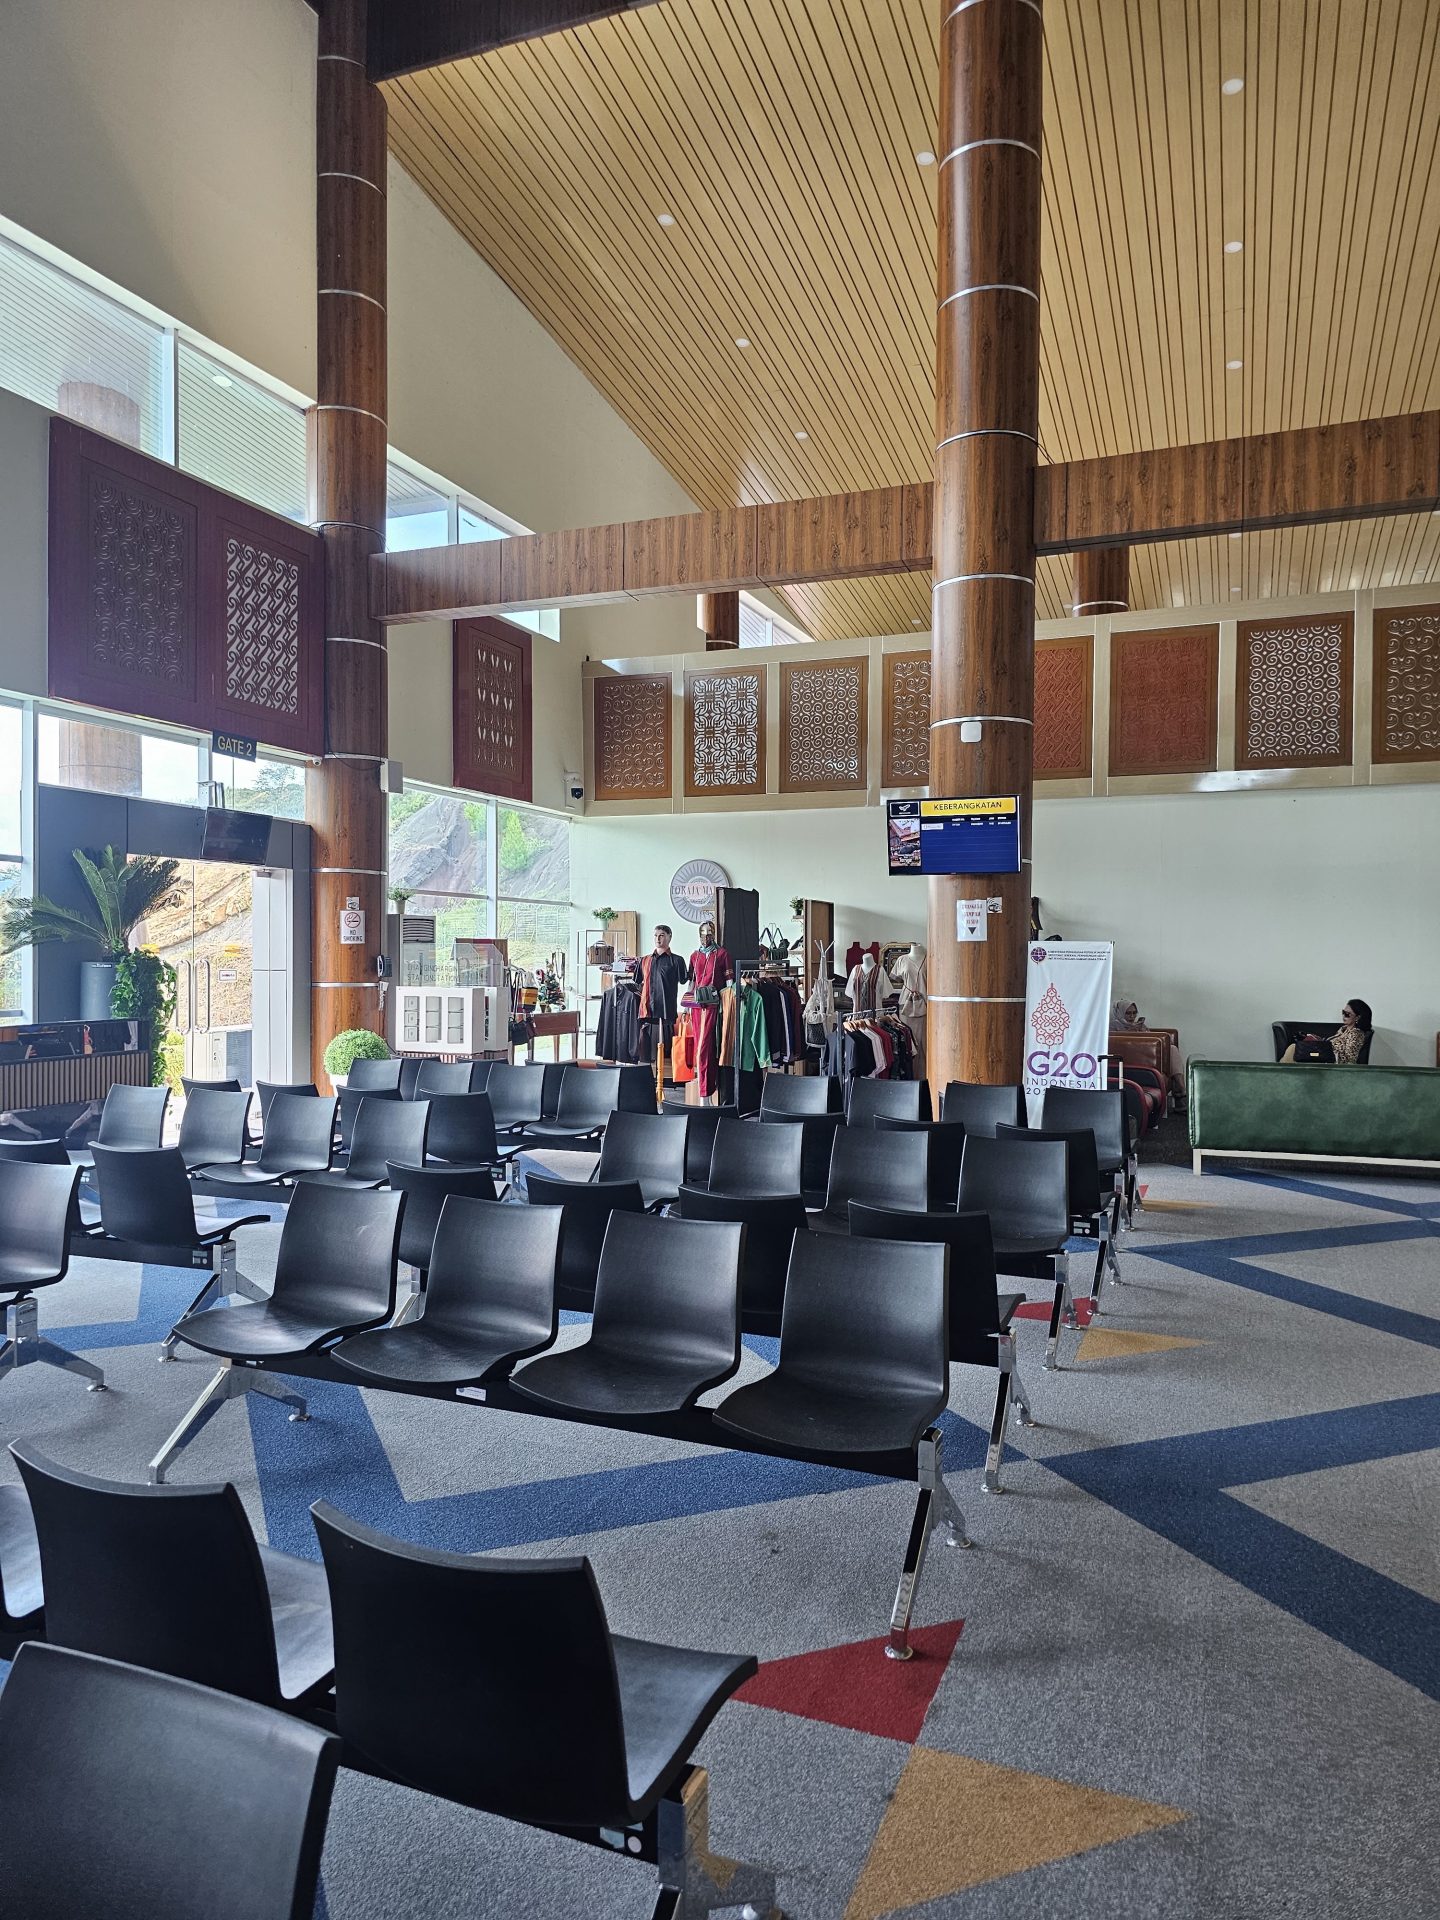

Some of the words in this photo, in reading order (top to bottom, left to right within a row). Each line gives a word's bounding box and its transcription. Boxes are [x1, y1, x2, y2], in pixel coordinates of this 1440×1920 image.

[217, 735, 244, 755] GATE
[246, 742, 253, 757] 2
[933, 801, 1003, 811] KEBERANGKATAN
[1026, 1050, 1097, 1079] G20
[1026, 1077, 1097, 1090] INDONESIA
